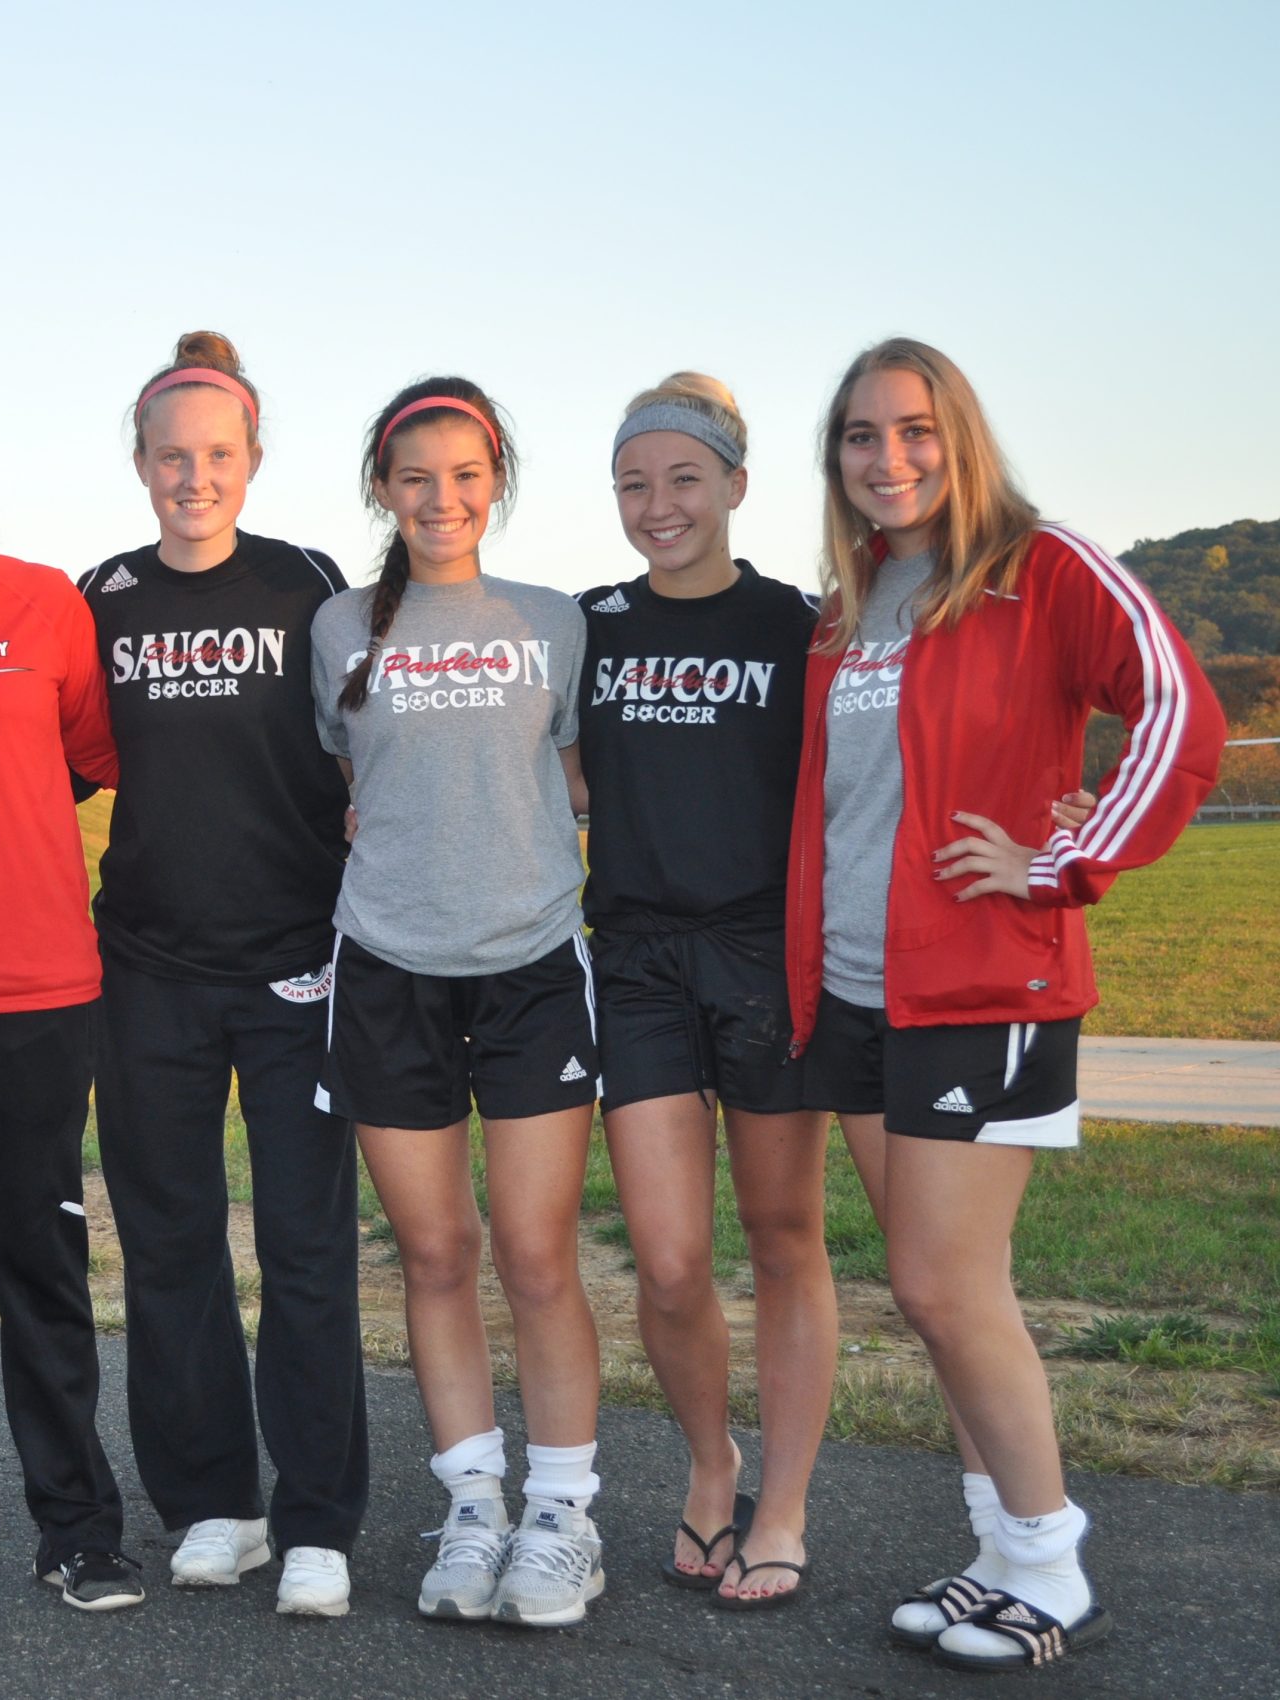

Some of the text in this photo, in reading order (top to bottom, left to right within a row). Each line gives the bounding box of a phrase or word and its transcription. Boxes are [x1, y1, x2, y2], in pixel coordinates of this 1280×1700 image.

[101, 577, 139, 593] adidas
[591, 601, 630, 613] adidas
[112, 627, 286, 683] SAUCON
[145, 640, 248, 667] Panthers
[383, 652, 512, 679] Panthers
[591, 657, 775, 708] SAUCON
[624, 664, 731, 690] Panthers
[833, 686, 900, 716] SOCCE
[560, 1069, 587, 1081] adidas
[932, 1102, 973, 1113] adidas
[460, 1505, 476, 1515] NIKE
[538, 1511, 557, 1522] NIKE
[996, 1612, 1037, 1625] adidas
